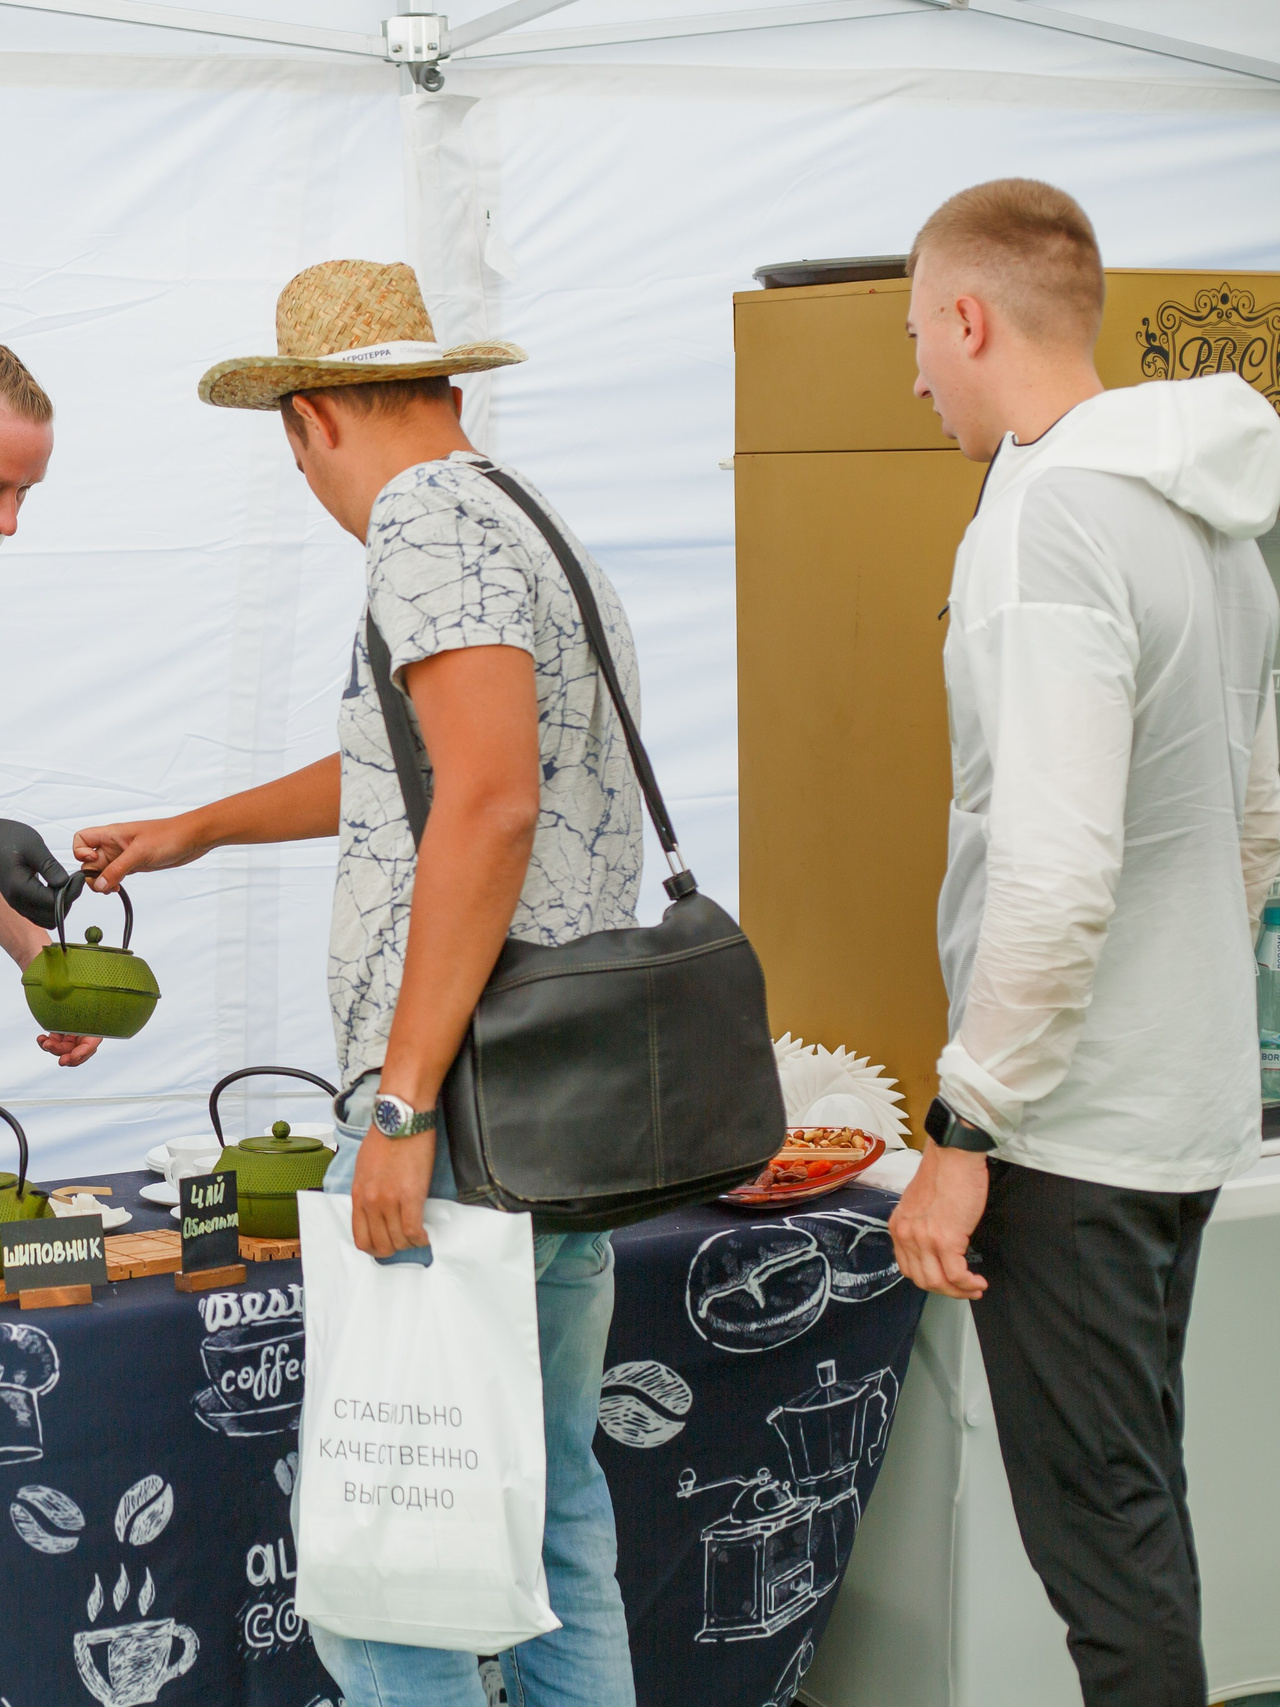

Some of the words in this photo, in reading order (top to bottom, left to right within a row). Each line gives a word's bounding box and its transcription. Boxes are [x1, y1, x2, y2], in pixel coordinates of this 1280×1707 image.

[190, 1174, 226, 1209] ЧАЙ
[3, 1236, 103, 1268] ШИПОВНИК
[202, 1283, 305, 1333] Best
[333, 1398, 463, 1428] СТАБИЛЬНО
[319, 1438, 479, 1471] КАЧЕСТВЕННО
[343, 1481, 455, 1512] ВЫГОДНО
